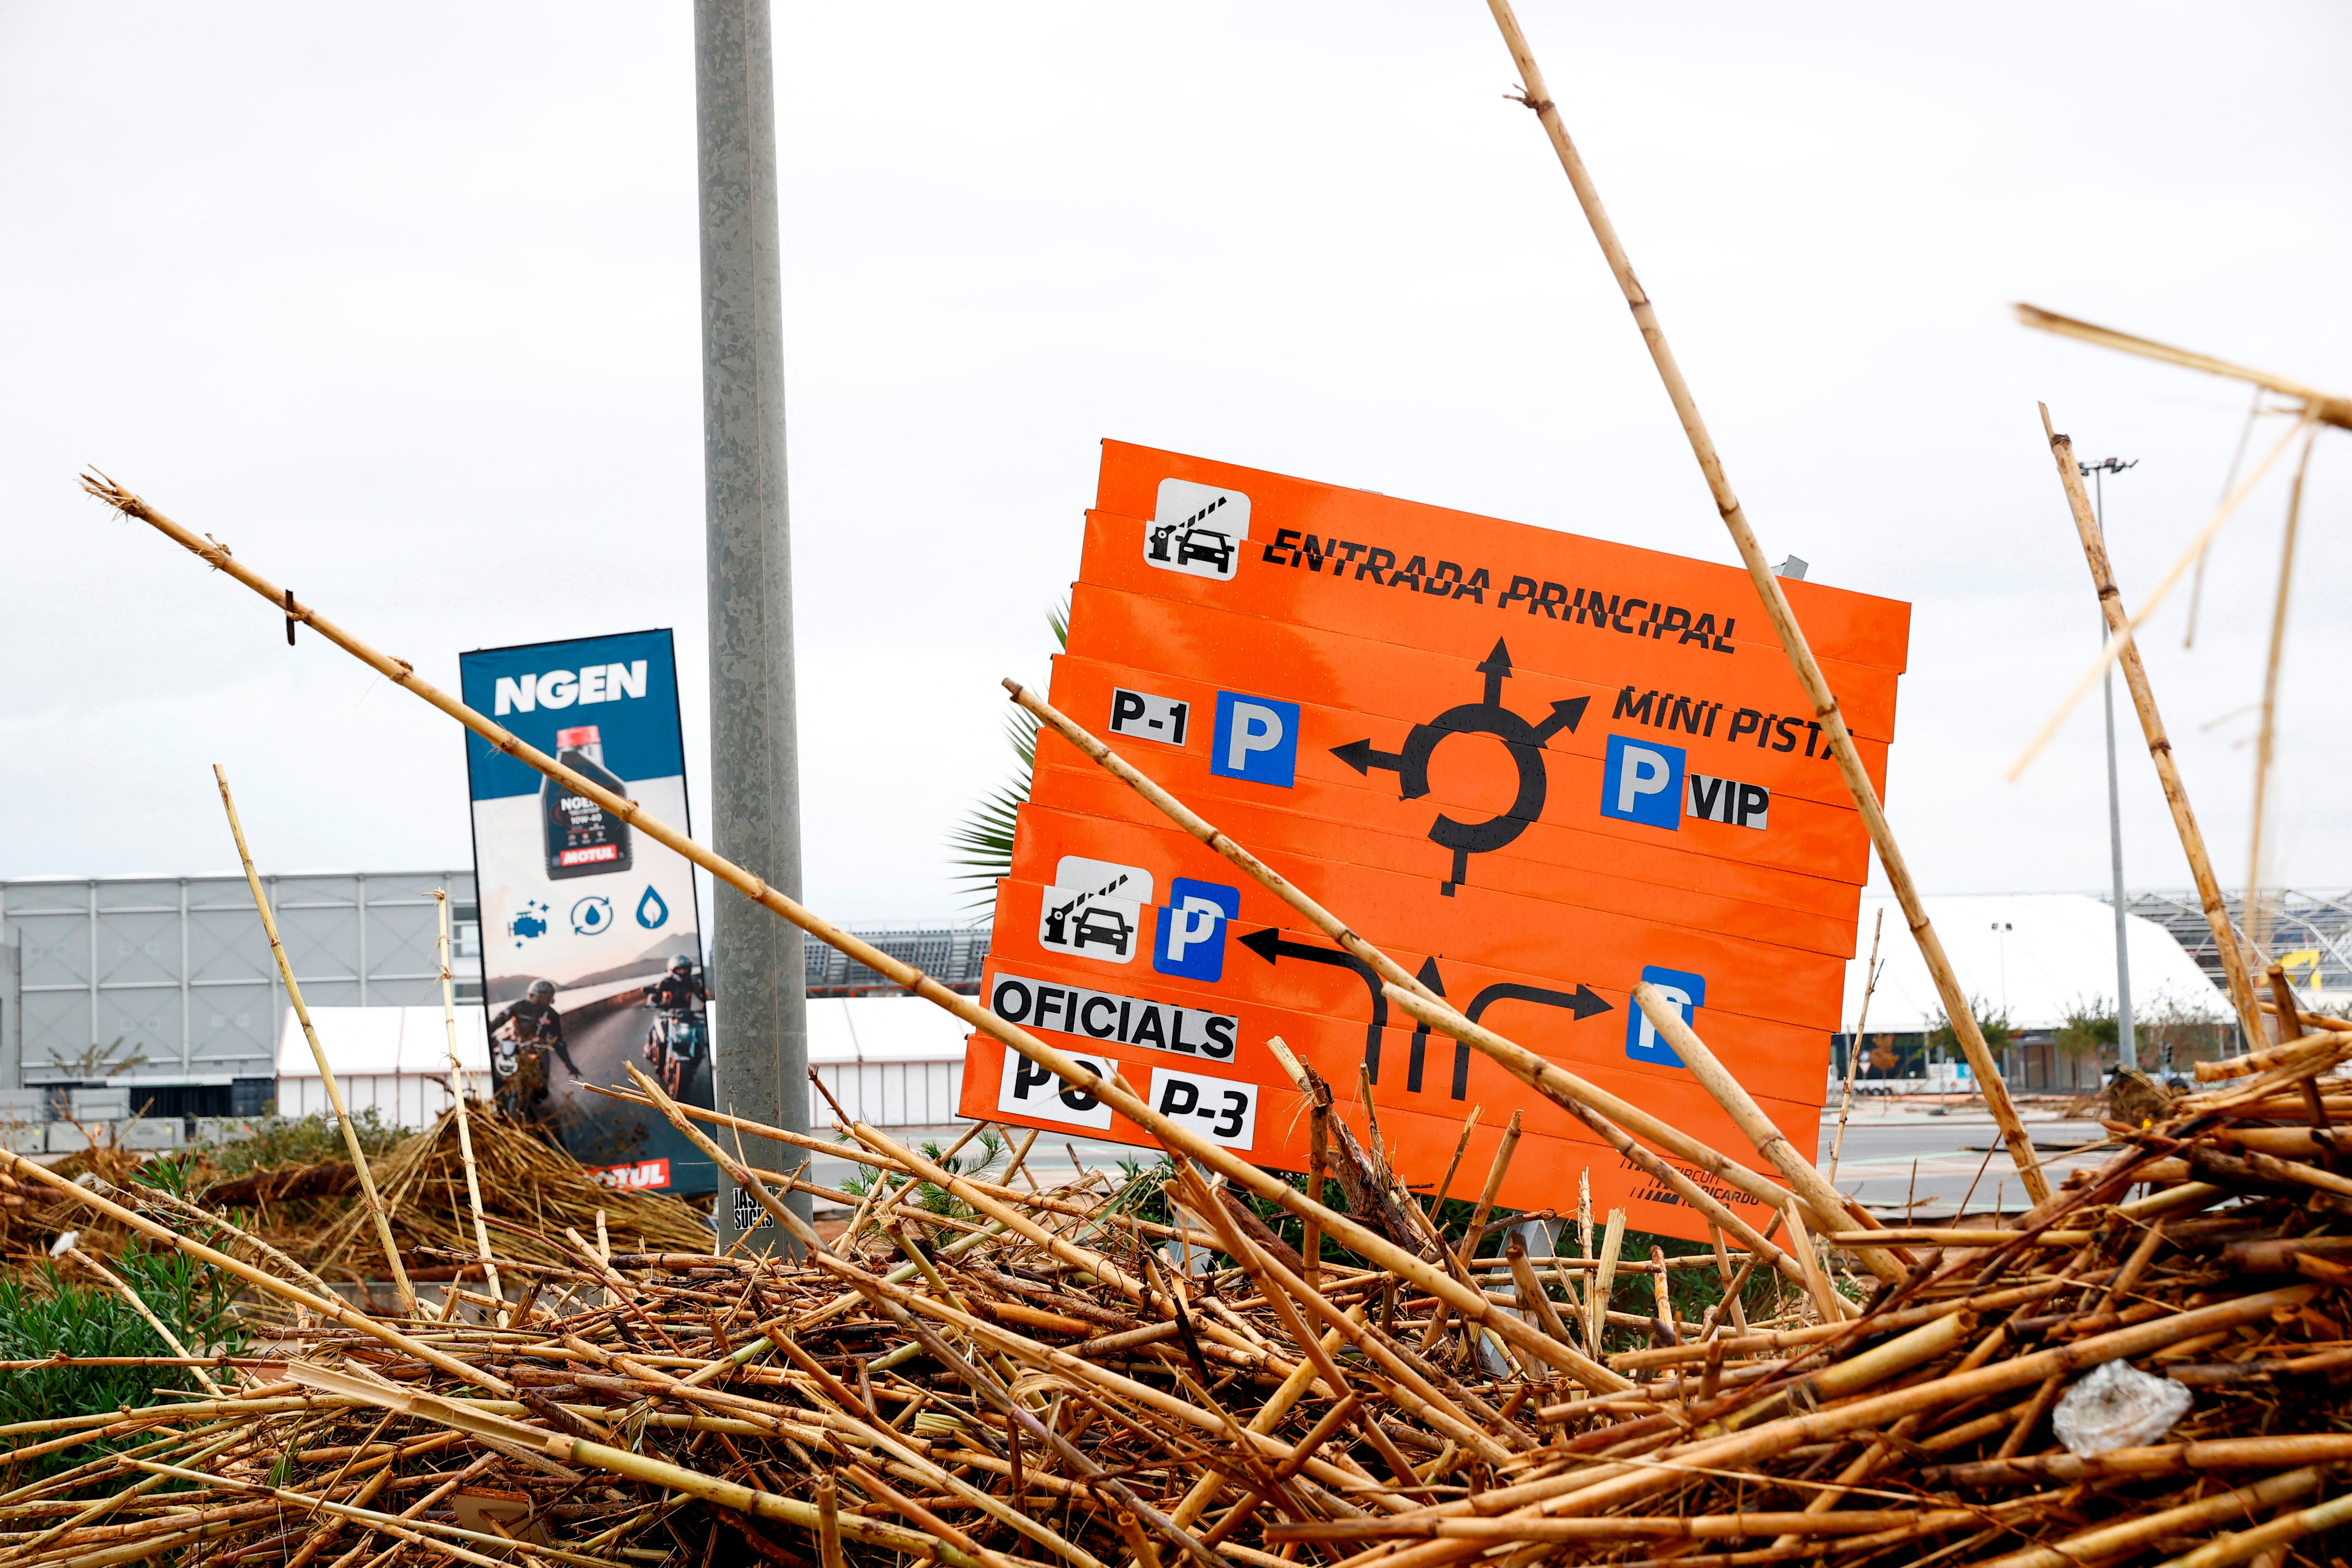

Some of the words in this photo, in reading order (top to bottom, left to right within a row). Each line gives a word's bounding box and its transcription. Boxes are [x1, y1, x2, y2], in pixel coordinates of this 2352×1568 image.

[1262, 528, 1489, 604] ENTRADA
[1498, 575, 1735, 654] PRINCIPAL
[495, 660, 647, 716] NGEN
[1612, 686, 1723, 737] MINI
[1112, 690, 1186, 744] P-1
[1228, 701, 1283, 771] P
[1618, 745, 1669, 813] P
[1691, 774, 1769, 826] VIP
[563, 846, 614, 865] MOTUL
[1167, 895, 1225, 962] P
[993, 980, 1236, 1059] OFICIALS
[1159, 1079, 1248, 1138] P-3
[583, 1163, 665, 1189] OTUL
